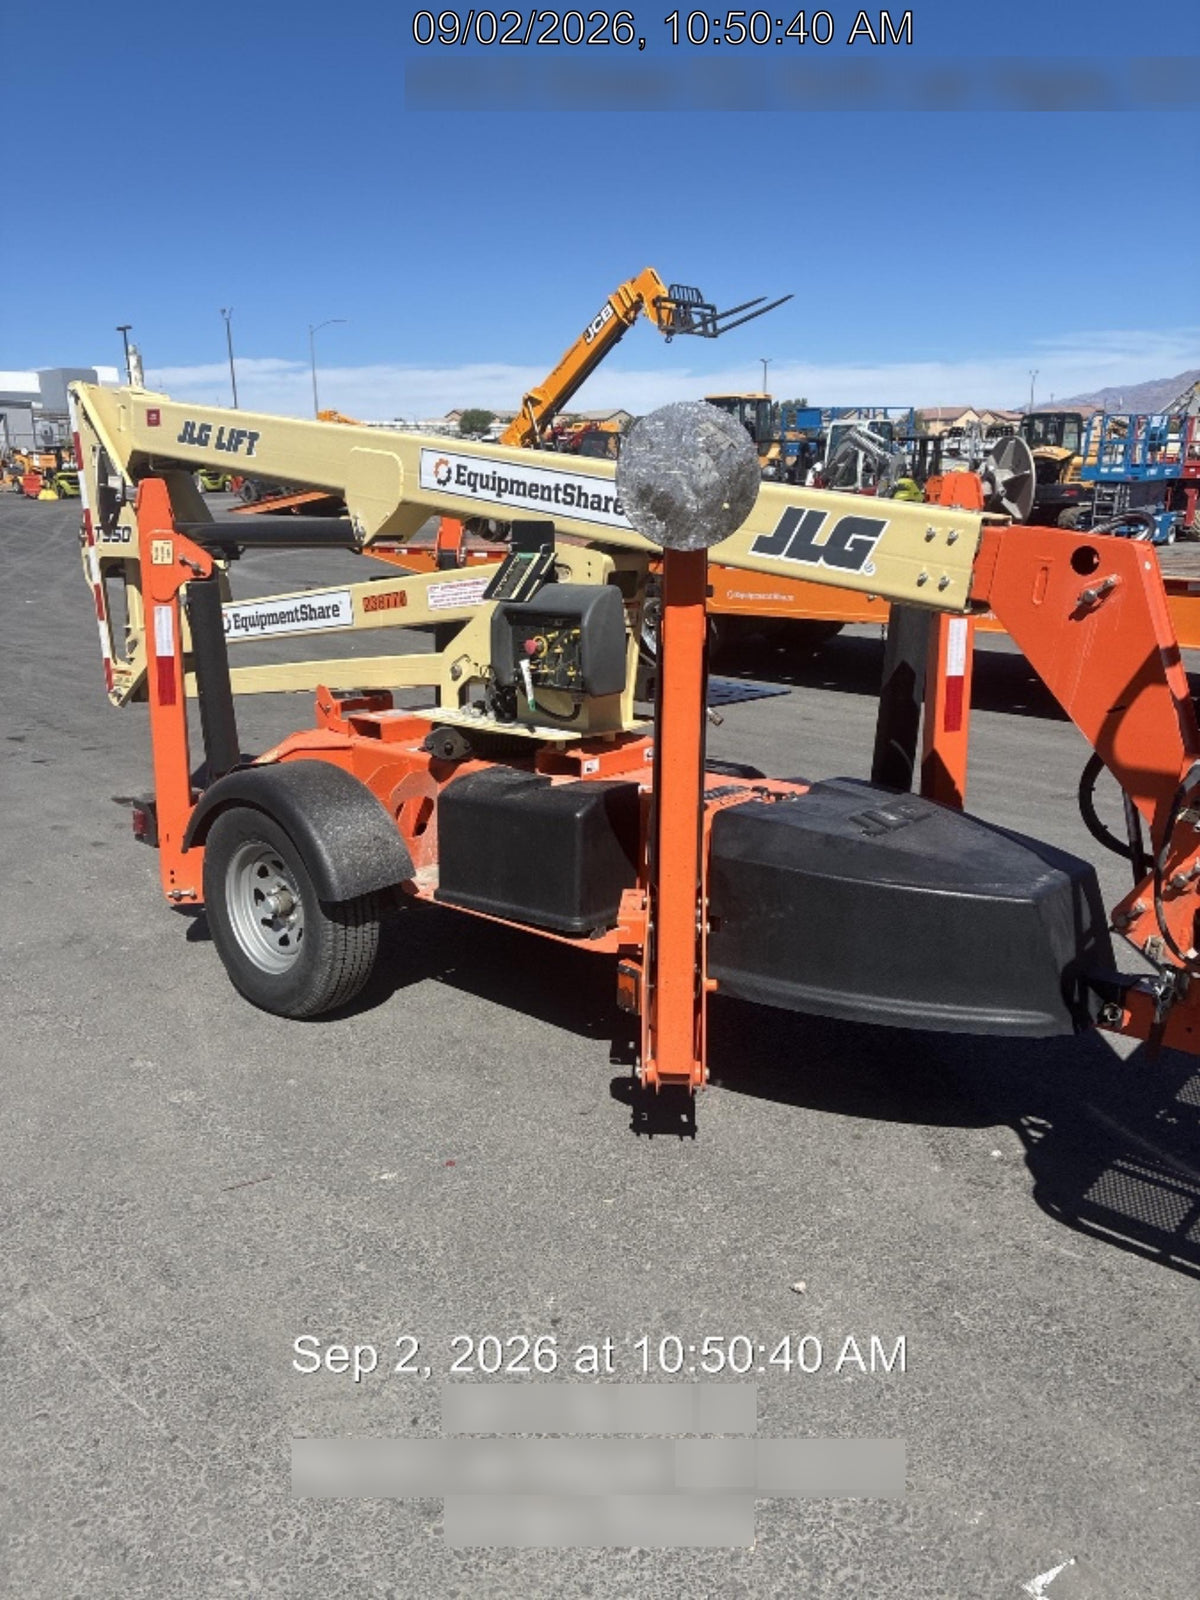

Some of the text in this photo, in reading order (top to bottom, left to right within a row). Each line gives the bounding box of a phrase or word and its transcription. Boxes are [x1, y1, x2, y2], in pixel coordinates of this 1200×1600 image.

[586, 303, 615, 344] JCB
[177, 420, 261, 457] JLG LIFT
[454, 463, 625, 516] EquipmentShare
[749, 505, 890, 574] JLG
[233, 602, 341, 631] EquipmentShare
